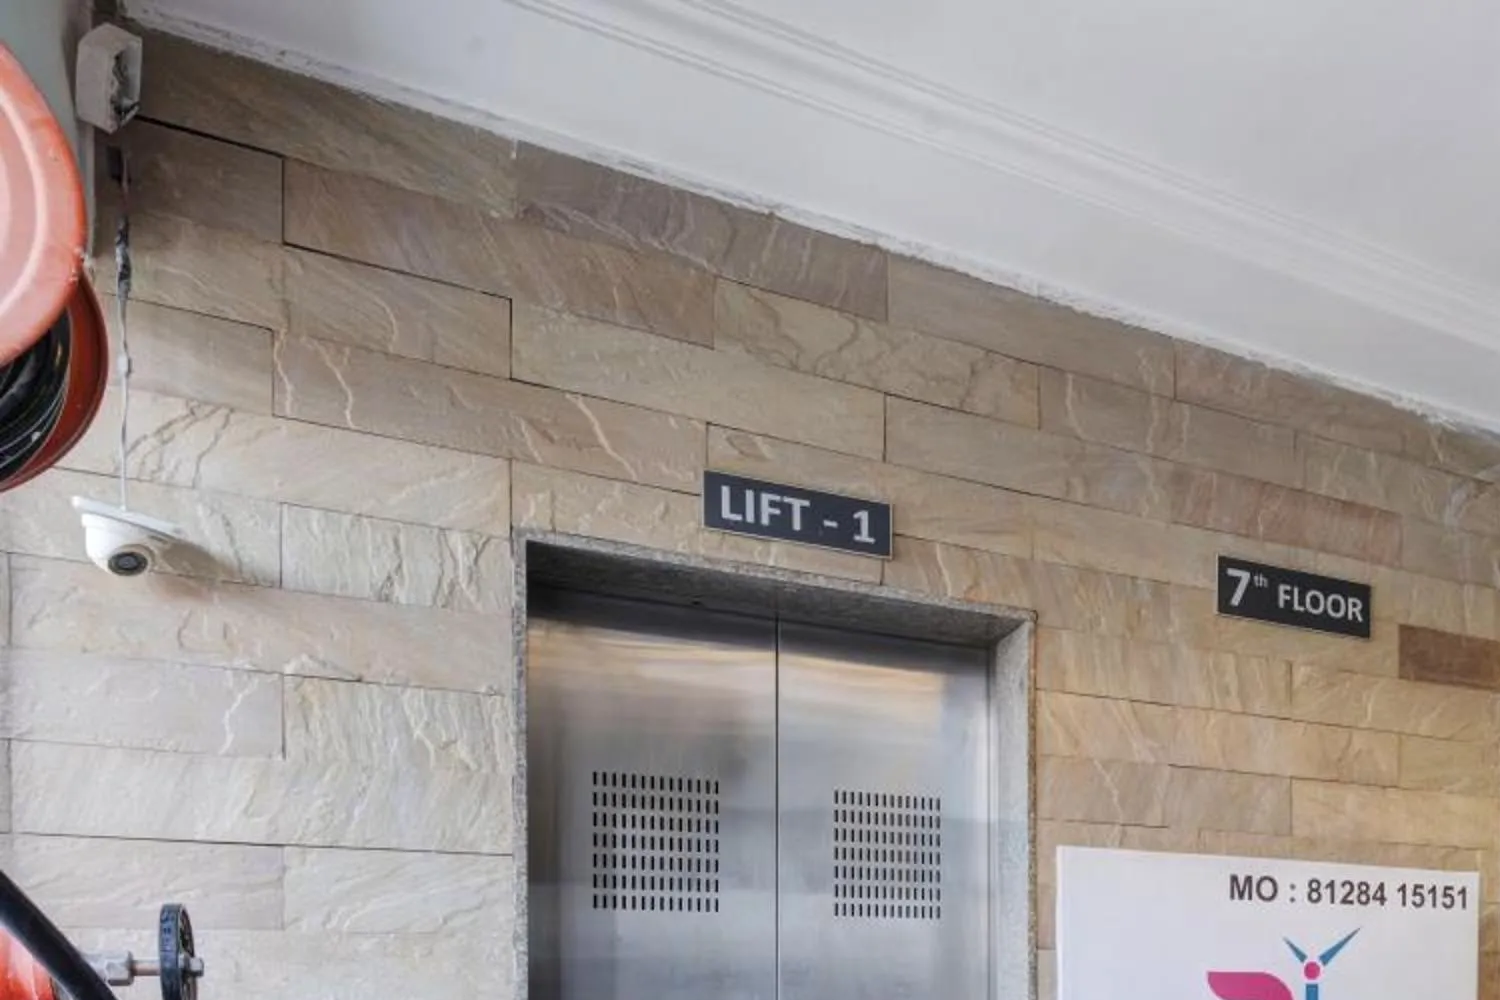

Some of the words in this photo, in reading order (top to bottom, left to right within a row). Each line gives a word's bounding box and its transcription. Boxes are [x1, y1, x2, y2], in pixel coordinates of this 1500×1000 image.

[721, 485, 810, 531] LIFT
[853, 510, 876, 544] 1
[1277, 584, 1364, 622] FLOOR
[1229, 874, 1279, 901] MO
[1306, 879, 1387, 906] 81284
[1396, 883, 1468, 909] 15151
